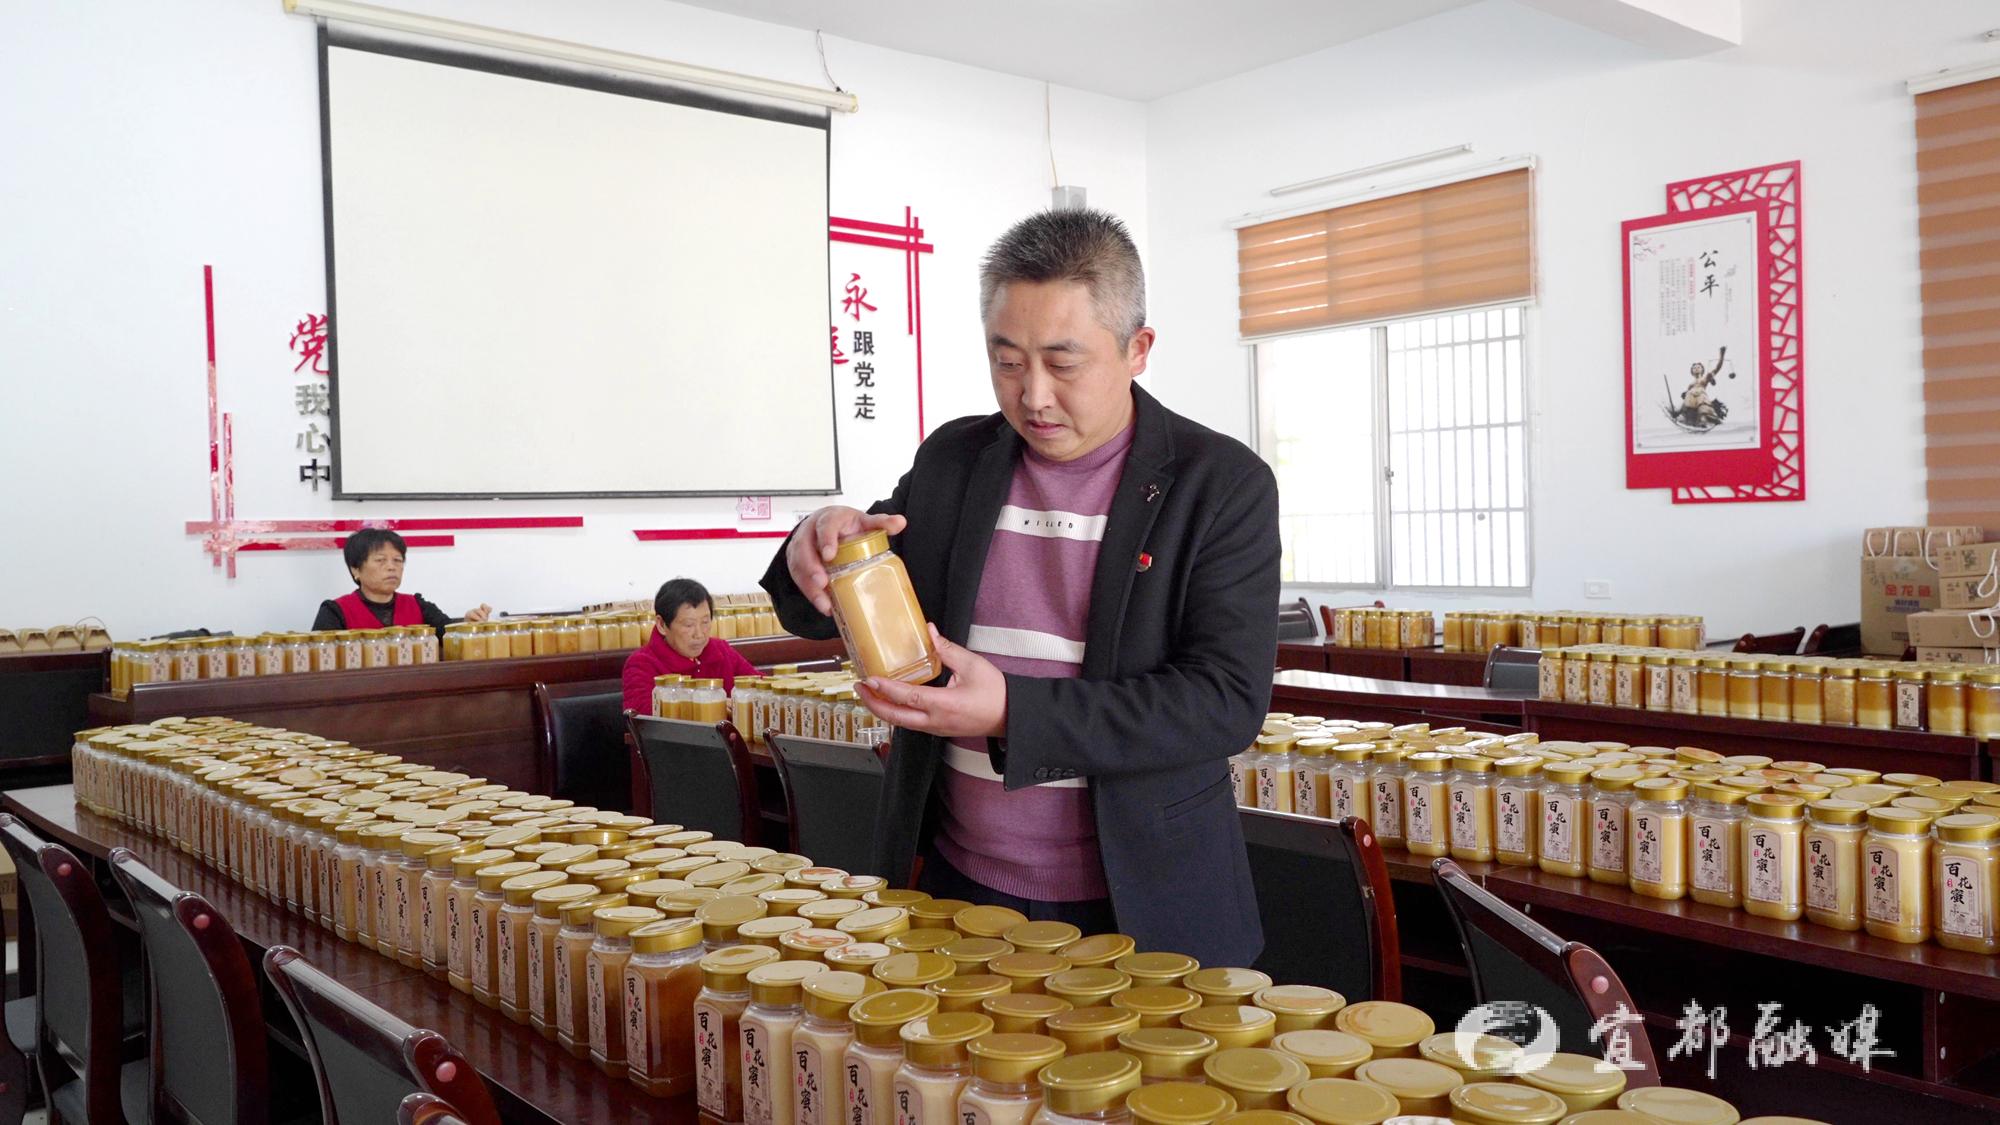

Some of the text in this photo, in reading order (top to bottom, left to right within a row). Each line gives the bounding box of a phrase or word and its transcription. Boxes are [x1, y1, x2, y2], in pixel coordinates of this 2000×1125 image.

[1698, 250, 1720, 298] 公平
[1336, 779, 1349, 810] 百花蜜
[1377, 782, 1394, 814] 百花蜜
[1410, 786, 1426, 819] 百花蜜
[1454, 791, 1470, 824] 百花蜜
[1501, 792, 1519, 826] 百花蜜
[1548, 801, 1566, 835] 百花蜜
[1598, 808, 1617, 844] 百花蜜
[1637, 818, 1656, 854] 百花蜜
[1699, 825, 1720, 863] 百花蜜
[1753, 834, 1775, 873] 百花蜜
[1809, 840, 1831, 880] 百花蜜
[1870, 851, 1893, 891] 百花蜜
[1945, 862, 1973, 904] 百花蜜
[698, 1011, 717, 1069] 百花蜜
[744, 1028, 764, 1088] 百花蜜
[797, 1050, 817, 1113] 百花蜜
